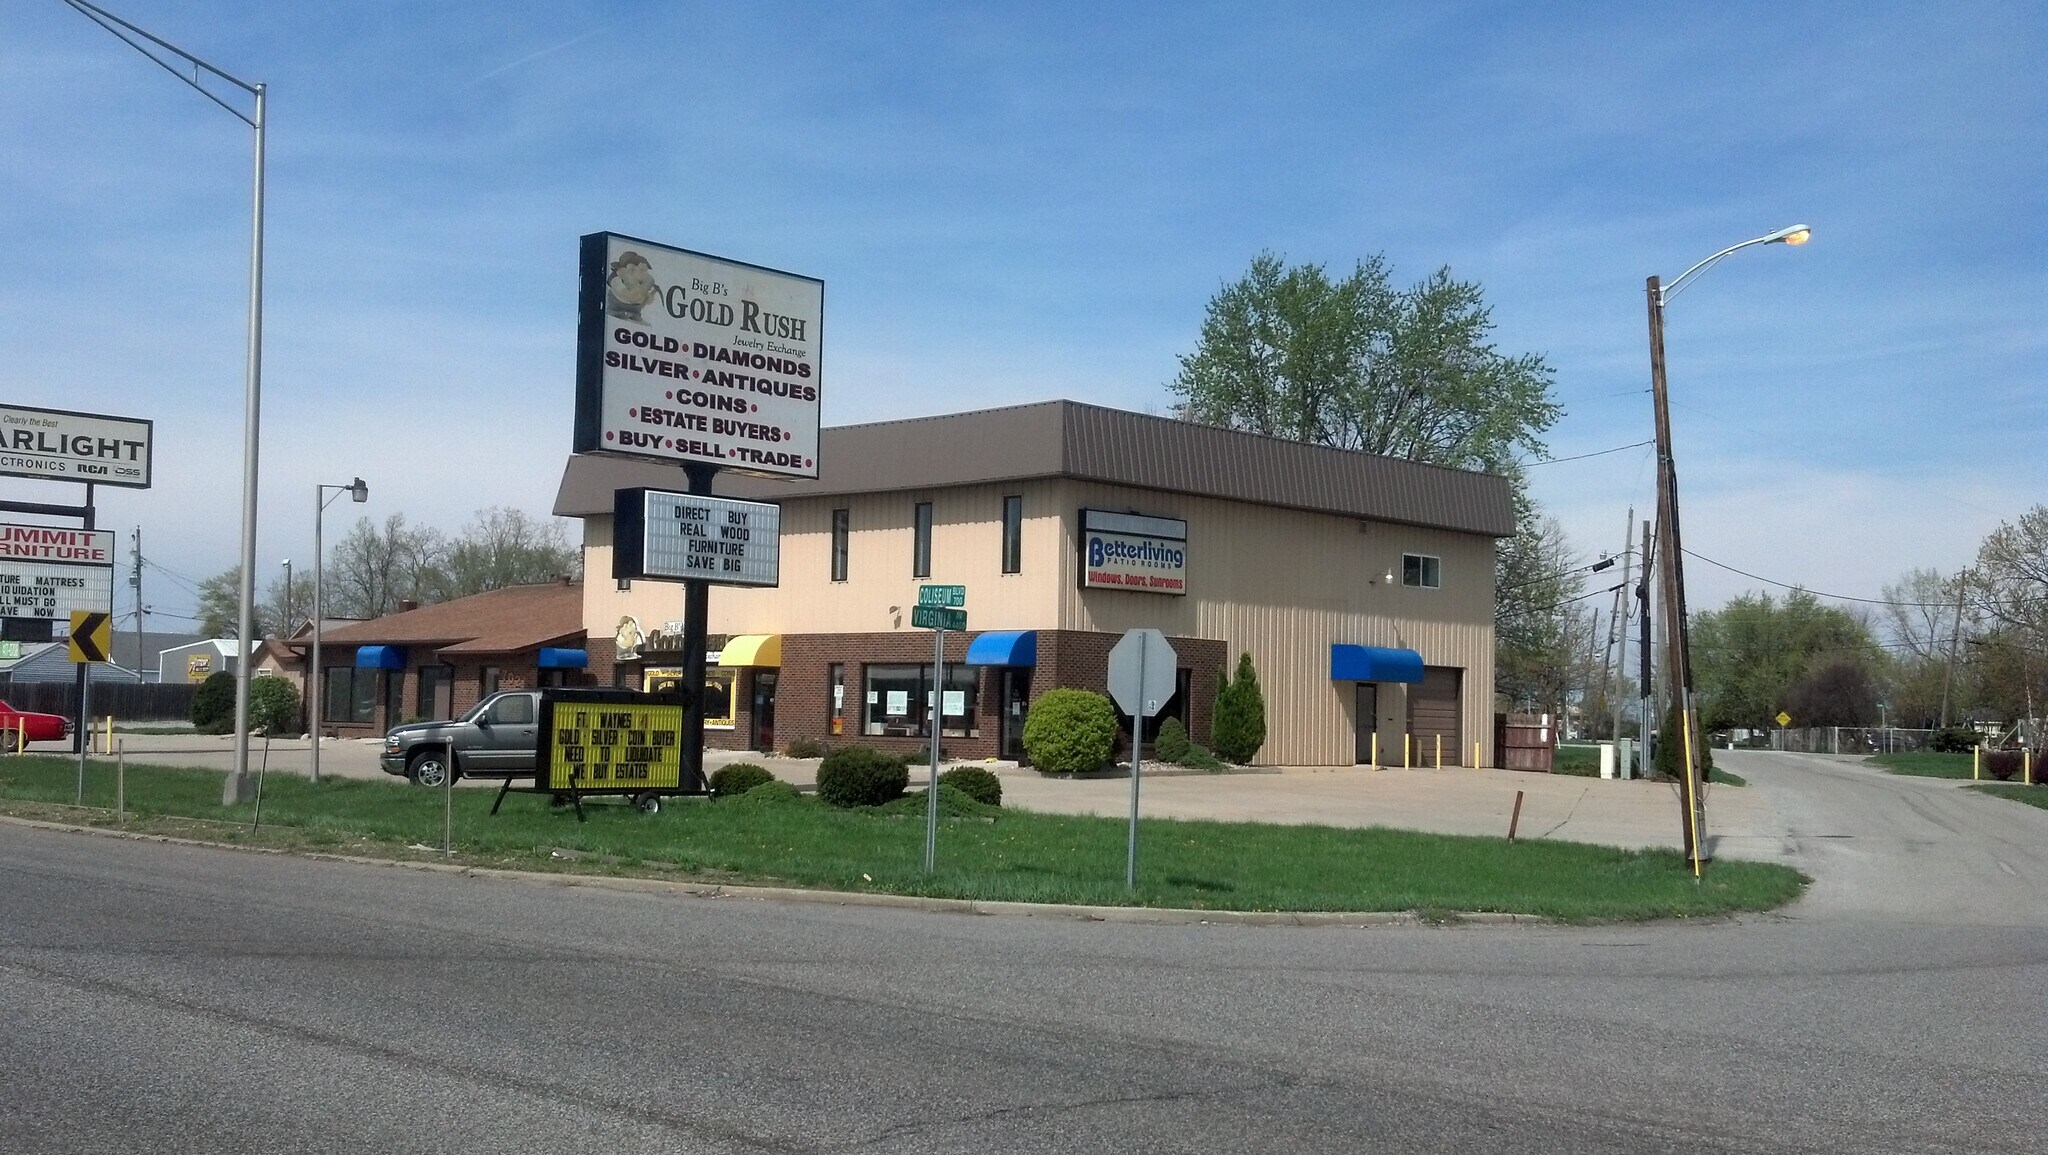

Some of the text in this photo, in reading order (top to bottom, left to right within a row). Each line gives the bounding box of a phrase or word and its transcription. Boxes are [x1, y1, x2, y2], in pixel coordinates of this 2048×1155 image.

[691, 278, 728, 296] Big B's
[666, 285, 806, 342] GOLD RUSH
[614, 328, 811, 378] GOLD DIAMONDS
[733, 335, 806, 358] Jewelry Exchange
[605, 350, 816, 401] SILVER ANTIQUES
[676, 389, 747, 414] COINS
[3, 414, 58, 428] Clearly the Best
[640, 406, 781, 442] ESTATE BUYERS
[619, 430, 802, 468] BUY SELL TRADE
[1, 457, 66, 471] CTRONICS
[77, 464, 108, 475] RCA
[674, 506, 748, 525] DIRECT BUY
[680, 523, 749, 541] REAL WOOD
[688, 540, 744, 556] FURNITURE
[1089, 537, 1183, 568] Betterliving
[687, 555, 741, 572] SAVE BIG
[1107, 557, 1171, 569] PATIO ROOMS
[36, 577, 85, 587] MATTRESS
[1149, 576, 1183, 589] Sunrooms
[14, 597, 39, 606] MUST
[44, 598, 56, 607] GO
[920, 588, 952, 604] COLISEUM
[0, 606, 55, 617] AVE NOW
[914, 610, 951, 628] VIRGINIA
[600, 713, 632, 728] WAYNES
[559, 729, 675, 746] GOLD SILVER COIN BUYER
[564, 746, 663, 762] NEED TO LIQUIDATE
[573, 763, 648, 779] WE BUY ESTATES
